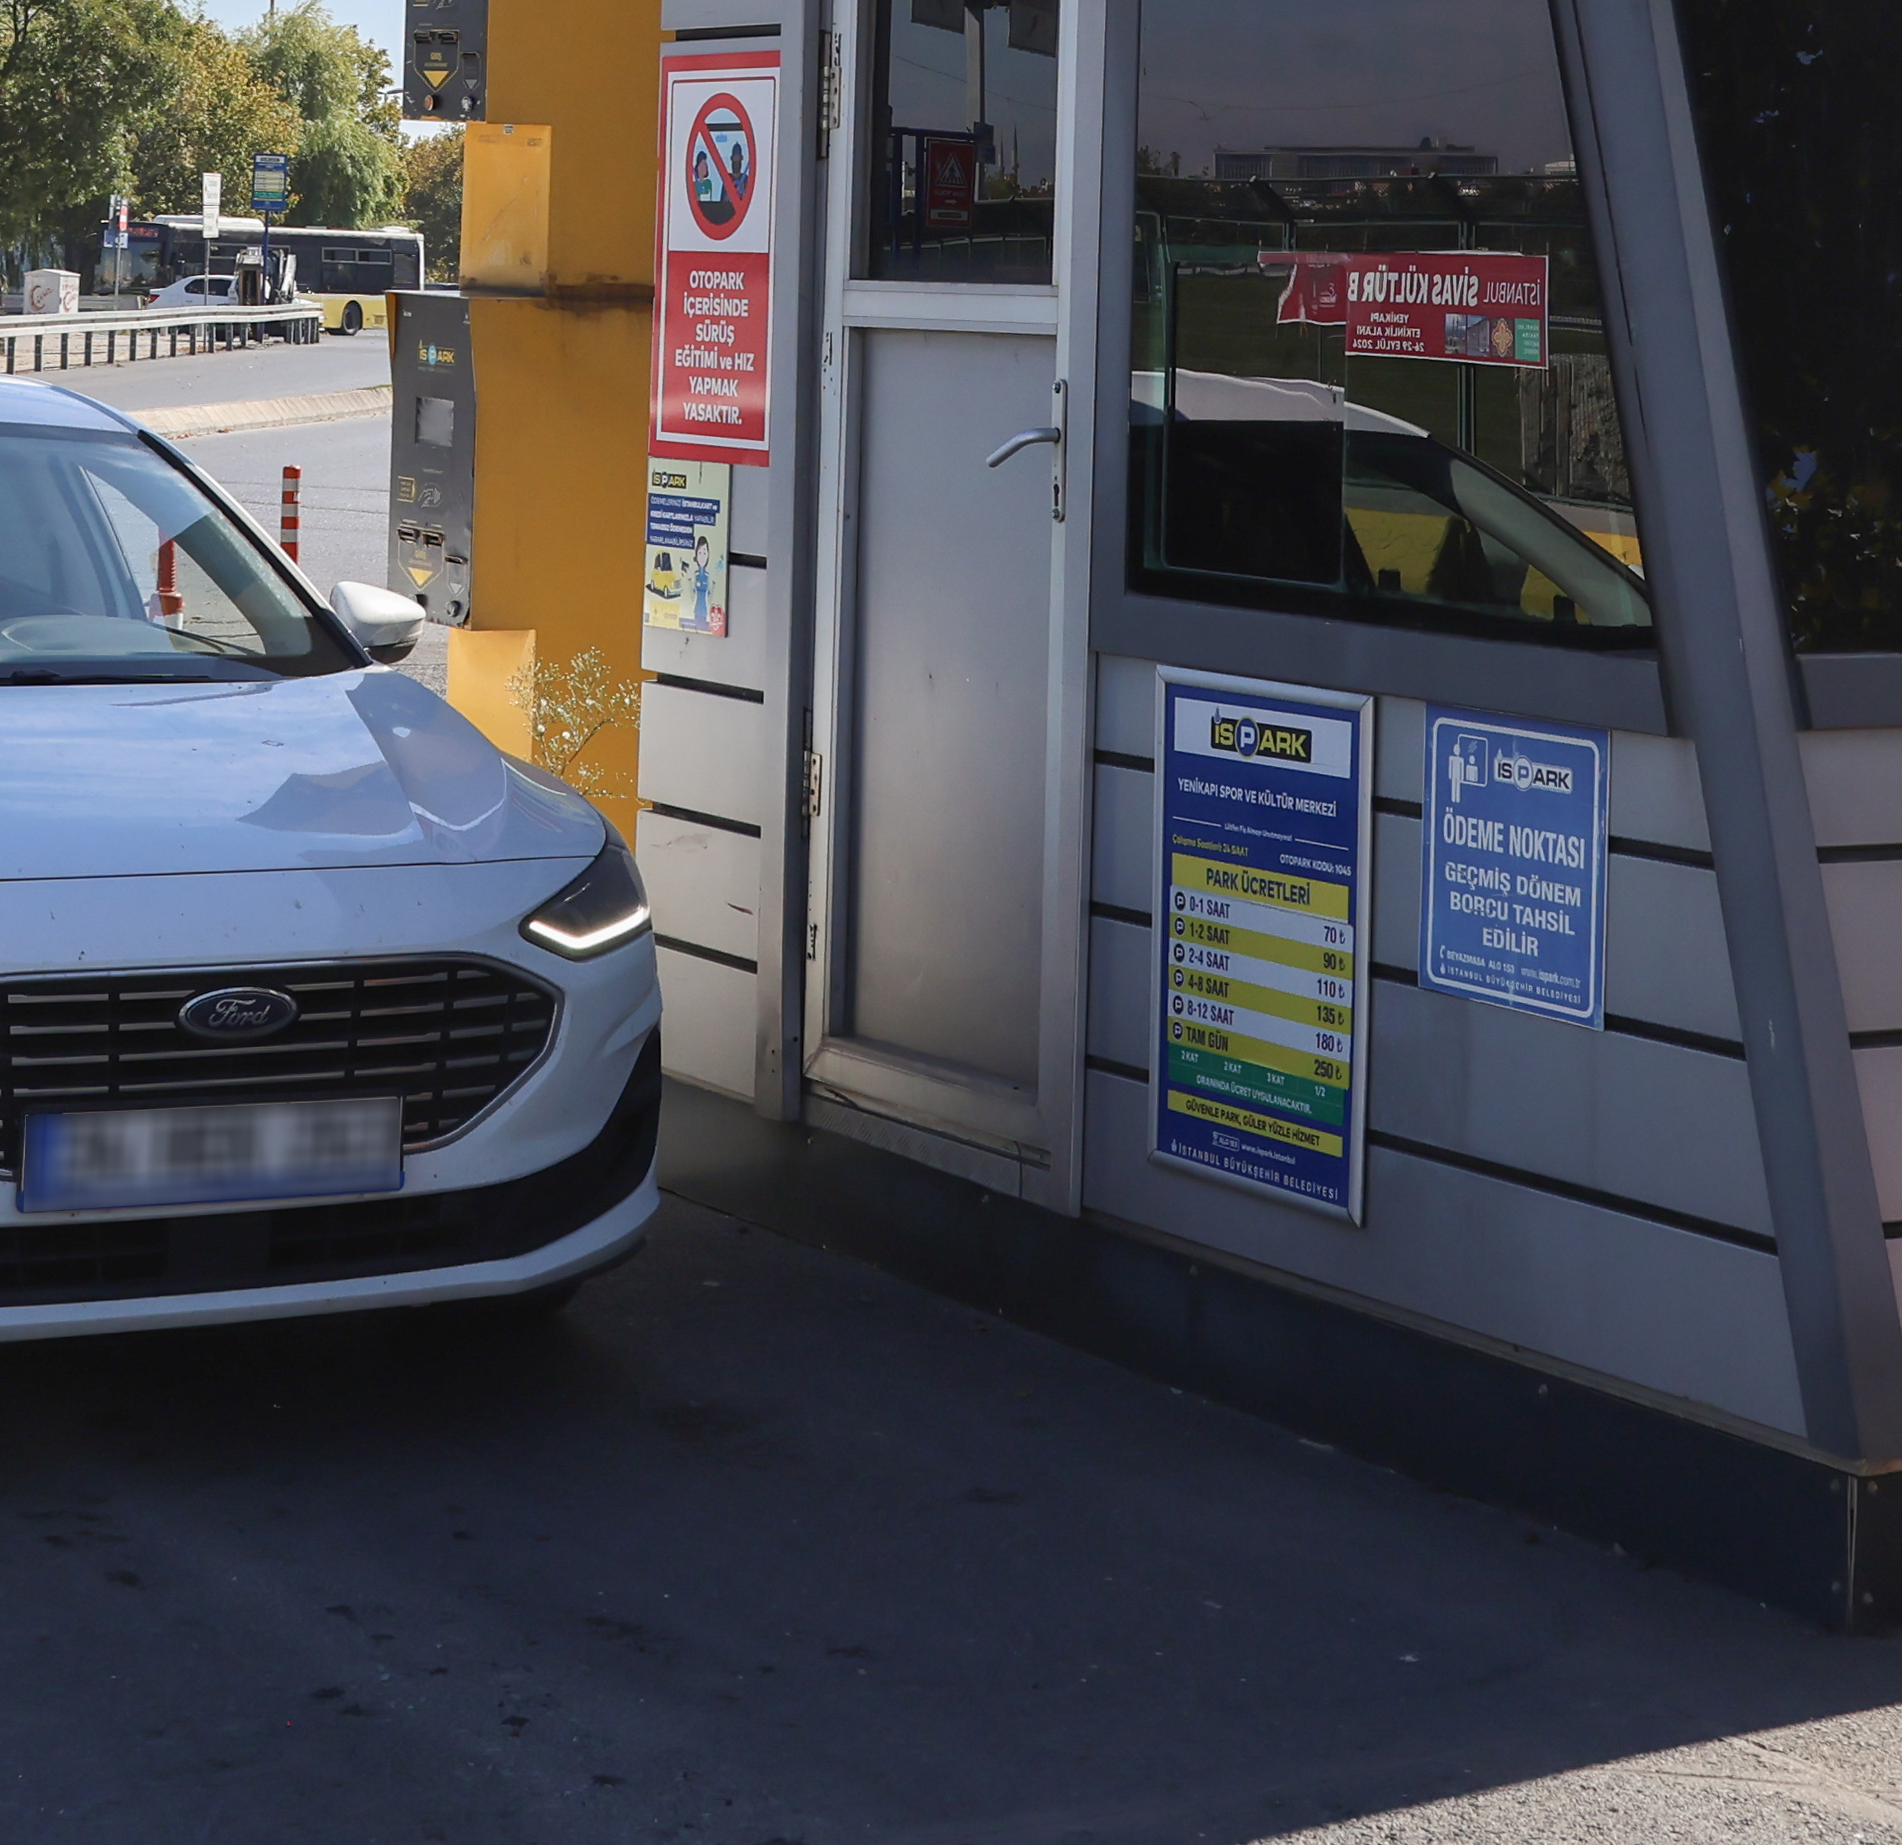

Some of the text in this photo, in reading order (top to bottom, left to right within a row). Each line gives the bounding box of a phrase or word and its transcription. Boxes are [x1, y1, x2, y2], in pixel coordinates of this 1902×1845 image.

[689, 270, 744, 290] OTOPARK
[683, 291, 749, 318] İÇERİSİNDE
[696, 319, 735, 347] SÜRÜŞ
[675, 344, 754, 371] EĞİTİMİ ve HIZ
[689, 376, 738, 397] YAPMAK
[683, 402, 742, 424] YASAKTIR.
[1178, 777, 1337, 817] YENİKAPI SPOR VE KÜLTÜR MERKEZİ
[1443, 808, 1585, 870] ÖDEME NOKTASI
[1280, 854, 1311, 868] OTOPARK
[1313, 859, 1334, 873] KODU:
[1206, 867, 1310, 905] PARK ÜCRETLERİ
[1445, 862, 1582, 907] GEÇMİŞ DÖNEM
[1189, 896, 1203, 913] 0-1
[1208, 899, 1230, 919] SAAT
[1324, 926, 1336, 944] 70
[1450, 891, 1575, 936] BORCU TAHSİL
[1190, 922, 1205, 939] 1-2
[1207, 925, 1230, 945] SAAT
[1323, 952, 1336, 970] 90
[1482, 924, 1539, 957] EDİLİR
[1189, 947, 1203, 965] 2-4
[1206, 951, 1230, 971] SAAT
[1317, 978, 1336, 998] 110
[1447, 965, 1483, 982] İSTANBUL
[1488, 960, 1501, 971] ALO
[1503, 963, 1515, 974] 153
[209, 999, 271, 1026] Ford
[1189, 974, 1203, 991] 4-8
[1206, 977, 1229, 998] SAAT
[1317, 1006, 1335, 1024] 135
[1186, 1026, 1228, 1052] TAM GÜN
[1187, 999, 1208, 1019] 8-12
[1210, 1006, 1234, 1026] SAAT
[1316, 1032, 1334, 1052] 180
[1229, 1063, 1242, 1074] KAT
[1272, 1074, 1285, 1085] KAT
[1314, 1059, 1333, 1079] 250
[1196, 1075, 1230, 1091] ORANINDA
[1231, 1082, 1251, 1097] ÜCRET
[1186, 1099, 1320, 1146] GÜVENLE PARK, GÜLER YÜZLE HİZMET
[1179, 1142, 1338, 1200] İSTANBUL BÜYÜKŞEHİR BELEDİYESİ
